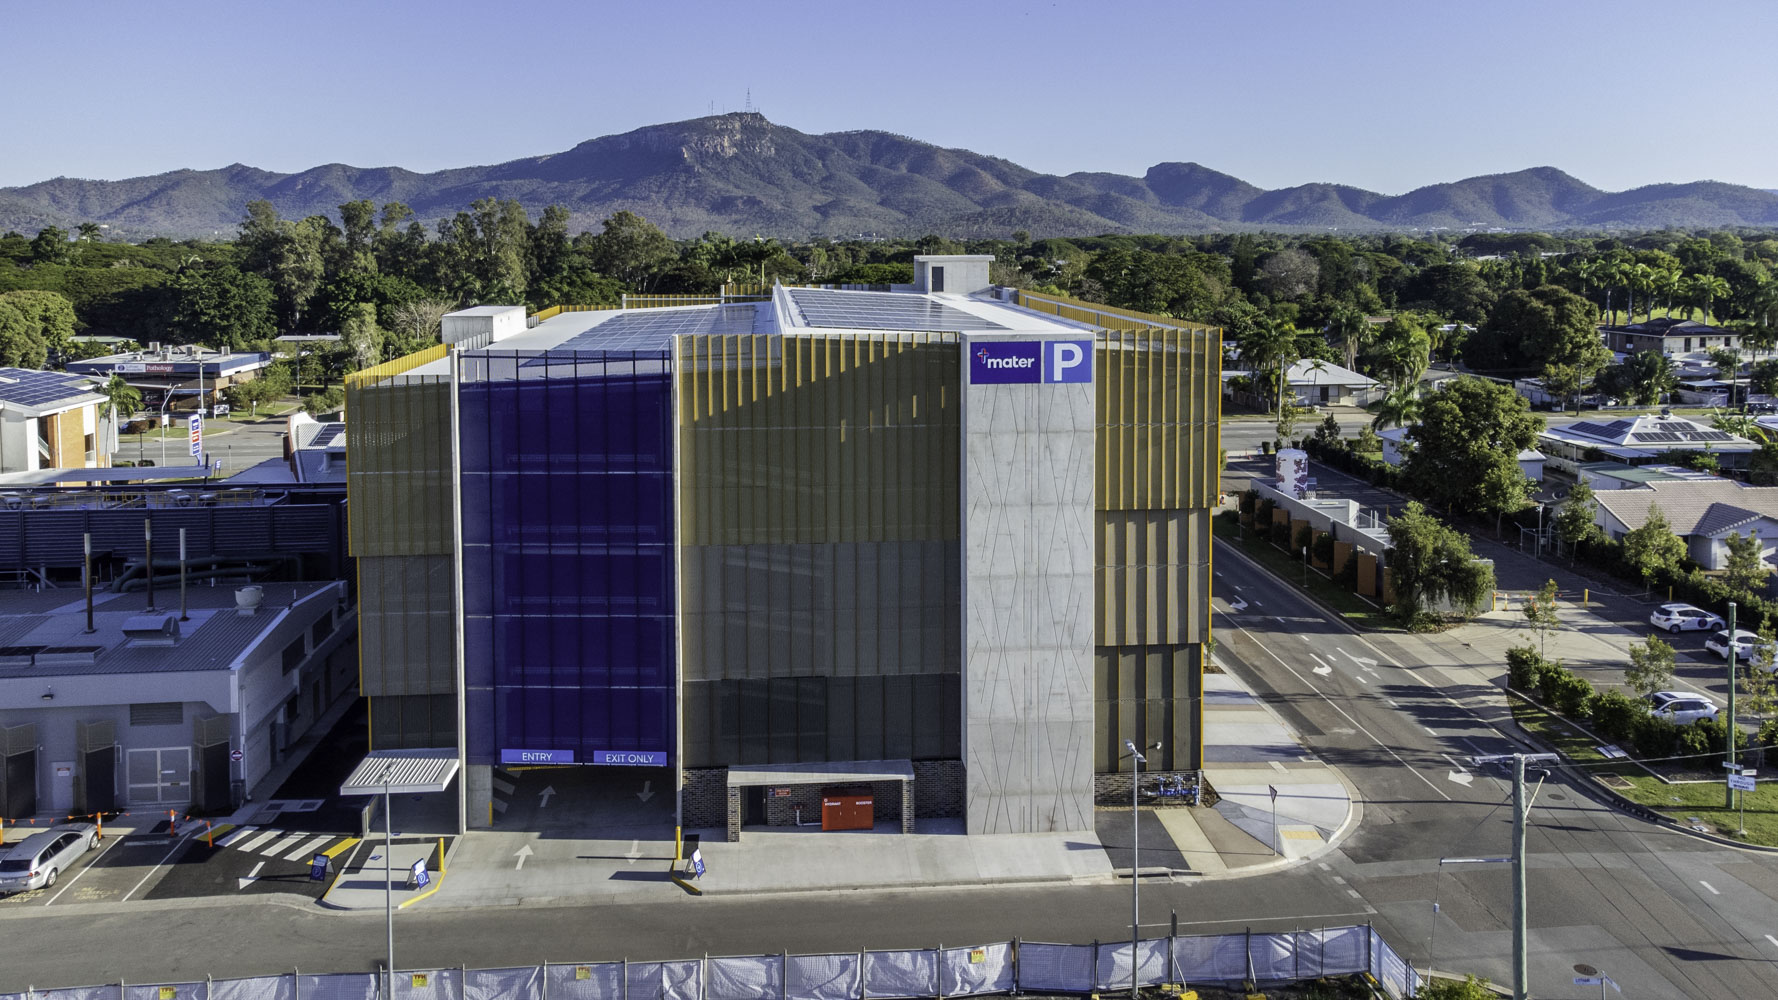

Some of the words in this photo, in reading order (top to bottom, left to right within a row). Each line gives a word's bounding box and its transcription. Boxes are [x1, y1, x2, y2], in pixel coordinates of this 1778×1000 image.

[987, 355, 1034, 368] mater
[1054, 343, 1083, 381] P
[522, 752, 552, 761] ENTRY
[606, 754, 626, 763] EXIT
[628, 754, 654, 763] ONLY
